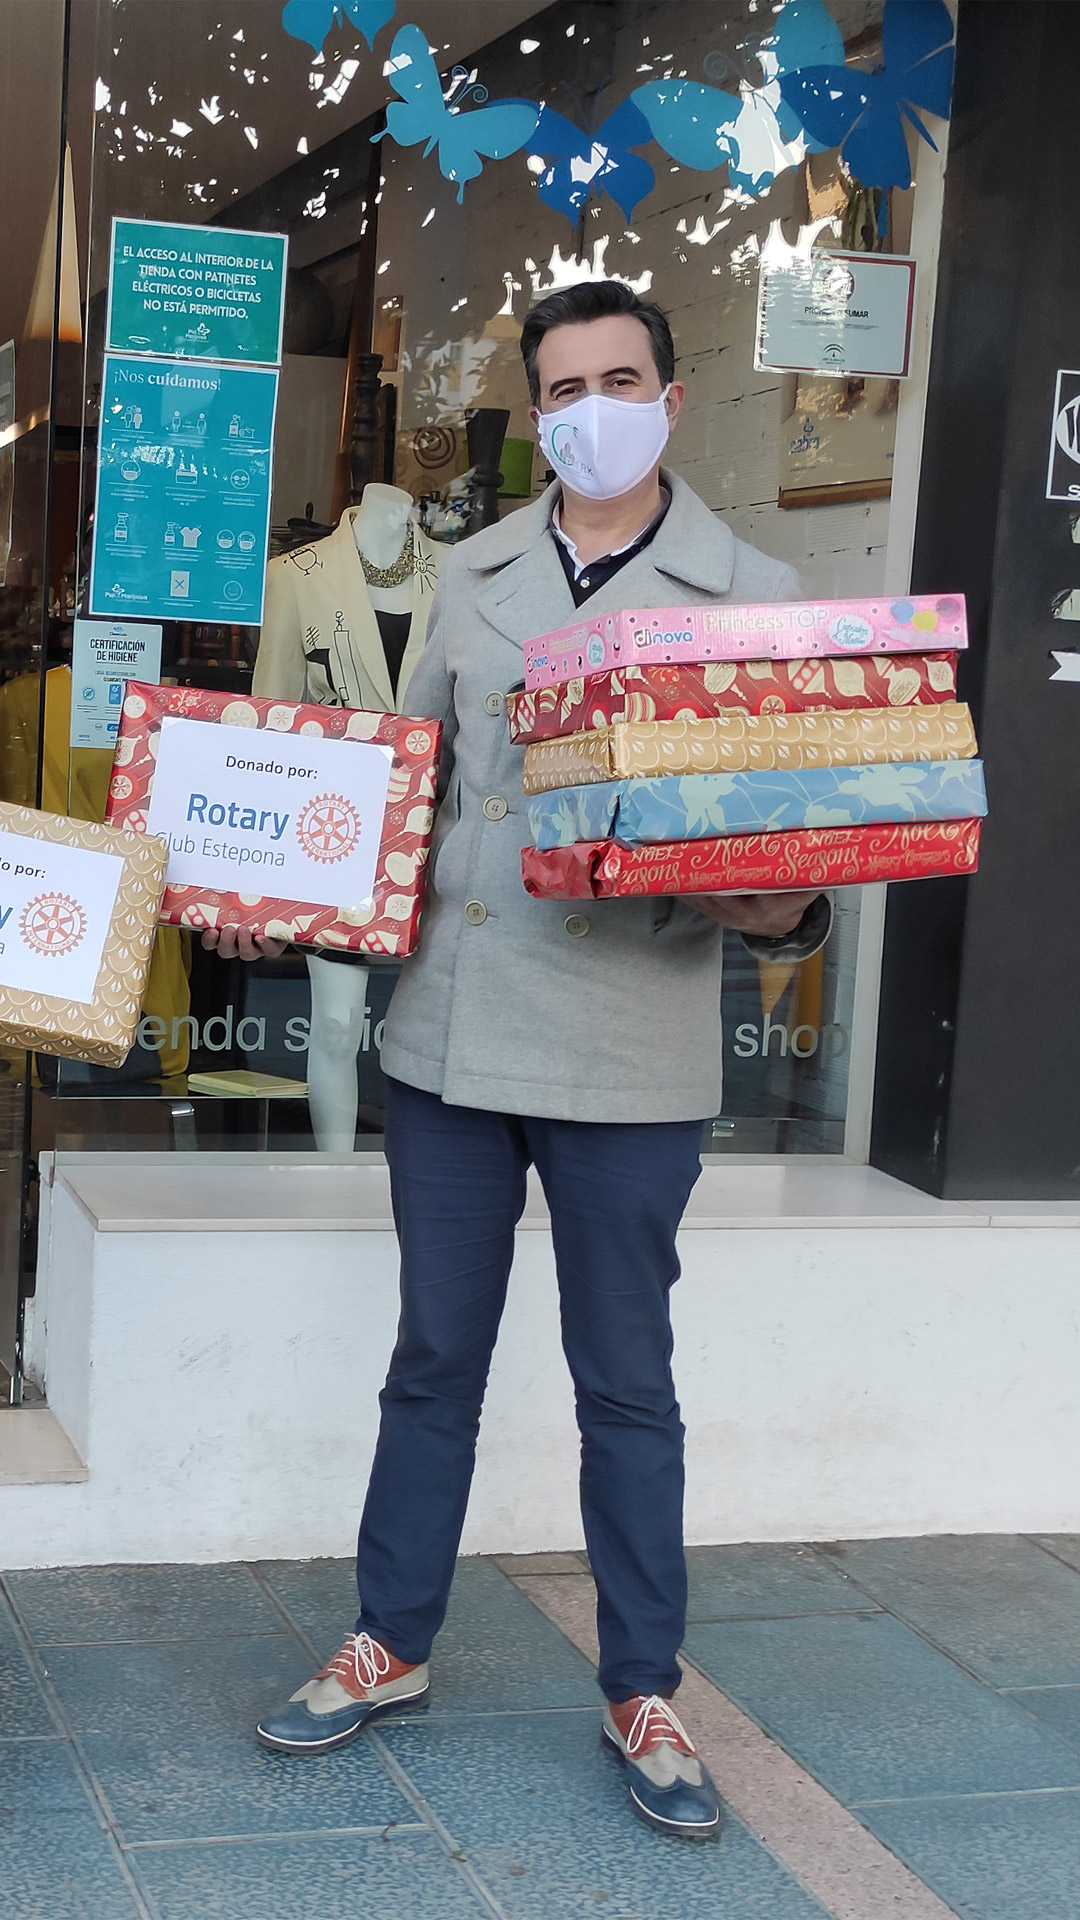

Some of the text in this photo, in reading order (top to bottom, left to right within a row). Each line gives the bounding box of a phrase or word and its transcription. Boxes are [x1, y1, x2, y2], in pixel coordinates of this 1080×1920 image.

[123, 246, 274, 270] EL ACCESO AL INTERIOR DE LA
[139, 264, 256, 286] TIENDA CON PATINETES
[132, 280, 261, 303] ELÉCTRICOS O BICICLETAS
[144, 300, 248, 319] NO ESTÁ PERMITIDO.
[114, 369, 221, 390] ¡Nos cuidamos!
[90, 639, 146, 652] CERTIFICACIÓN
[633, 630, 693, 648] dinova
[96, 650, 138, 662] DE HIGIENE
[226, 755, 318, 780] Donado por:
[318, 799, 345, 811] ROTARY
[186, 793, 290, 840] Rotary
[155, 832, 286, 867] Club Estepona
[14, 864, 47, 879] por:
[44, 899, 72, 911] ROTARY
[138, 1004, 266, 1052] enda
